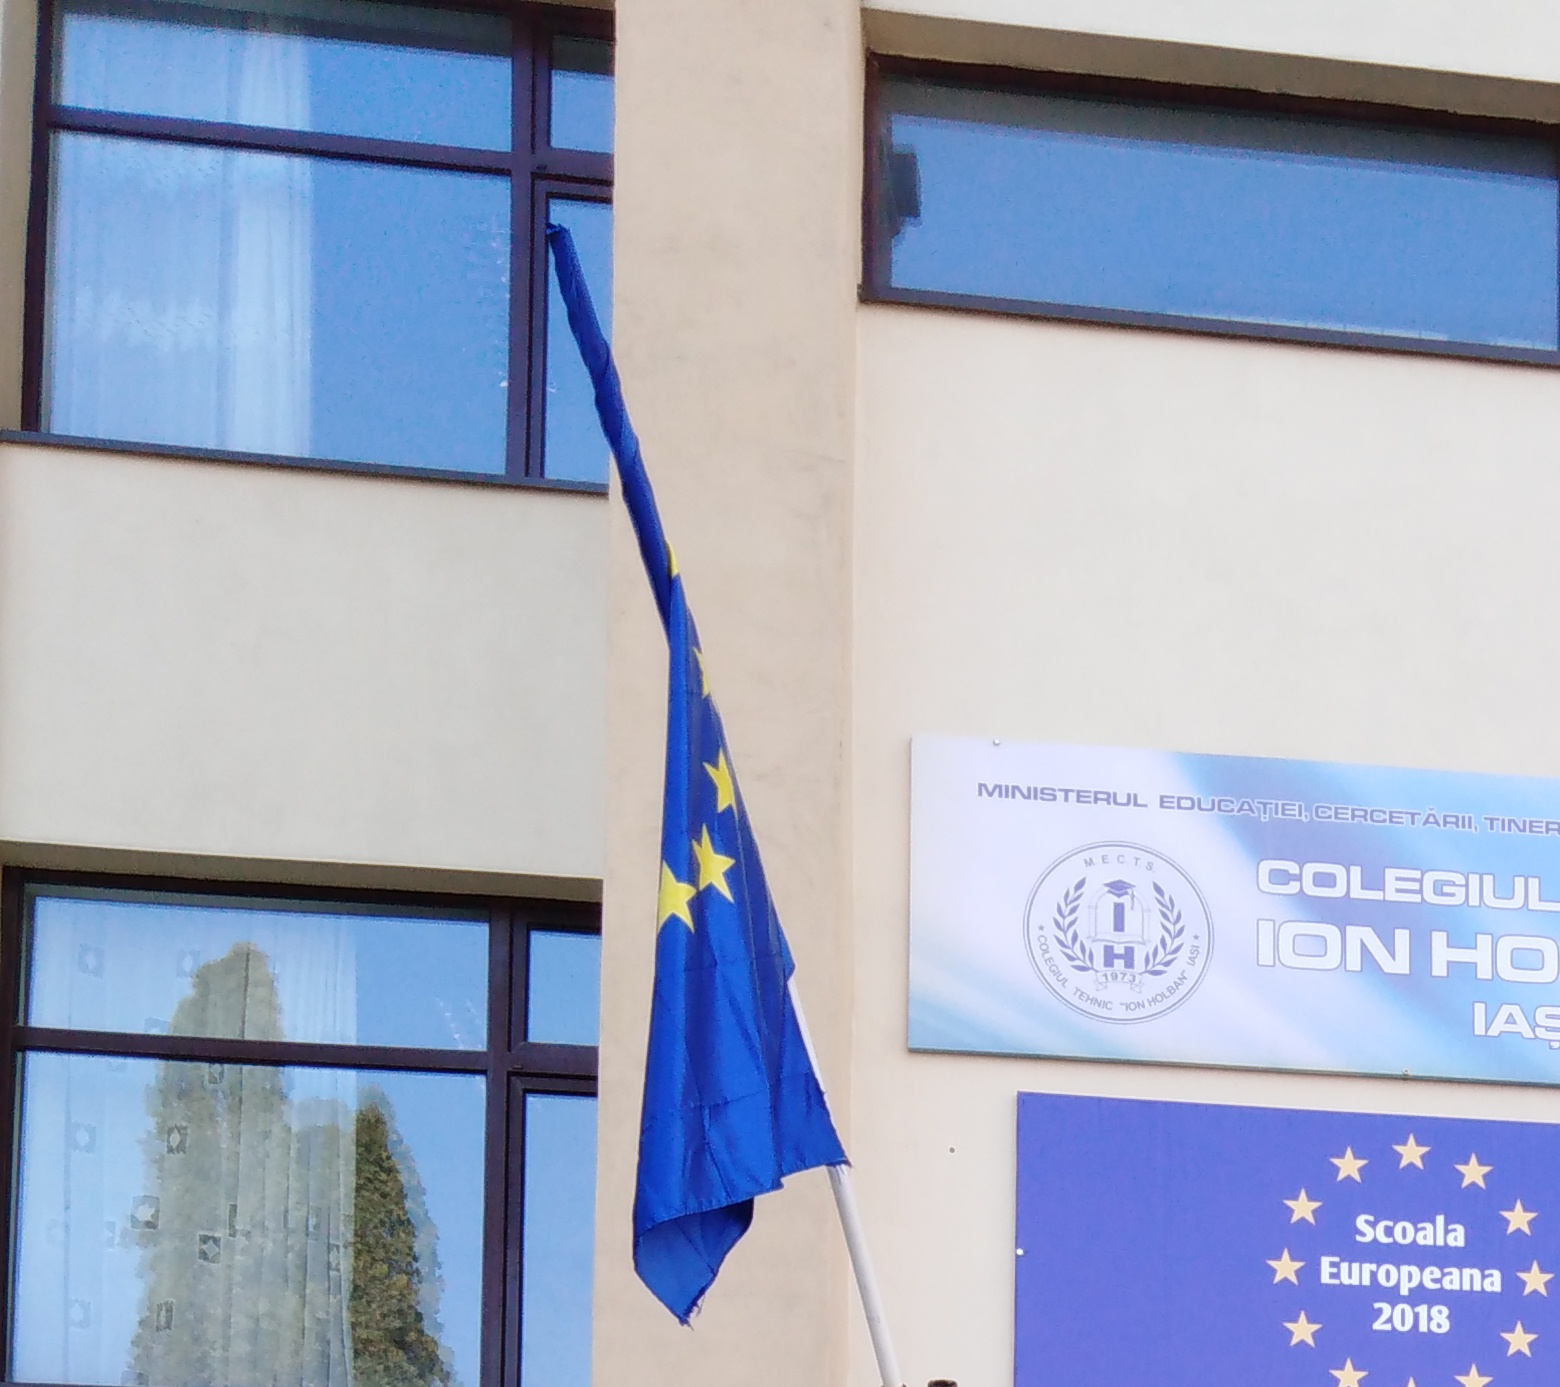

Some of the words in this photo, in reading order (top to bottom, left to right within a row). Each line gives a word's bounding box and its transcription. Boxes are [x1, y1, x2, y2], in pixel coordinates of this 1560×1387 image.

[977, 783, 1148, 808] MINISTERUL
[1313, 804, 1478, 833] CERCETĂRII,
[1255, 918, 1412, 976] ION
[1037, 934, 1068, 989] COLEGIUL
[1072, 987, 1113, 1010] TEHNIC
[1102, 971, 1136, 983] 1973
[1355, 1213, 1466, 1248] Scoala
[1320, 1255, 1502, 1296] Europeana
[1372, 1301, 1451, 1334] 2018
